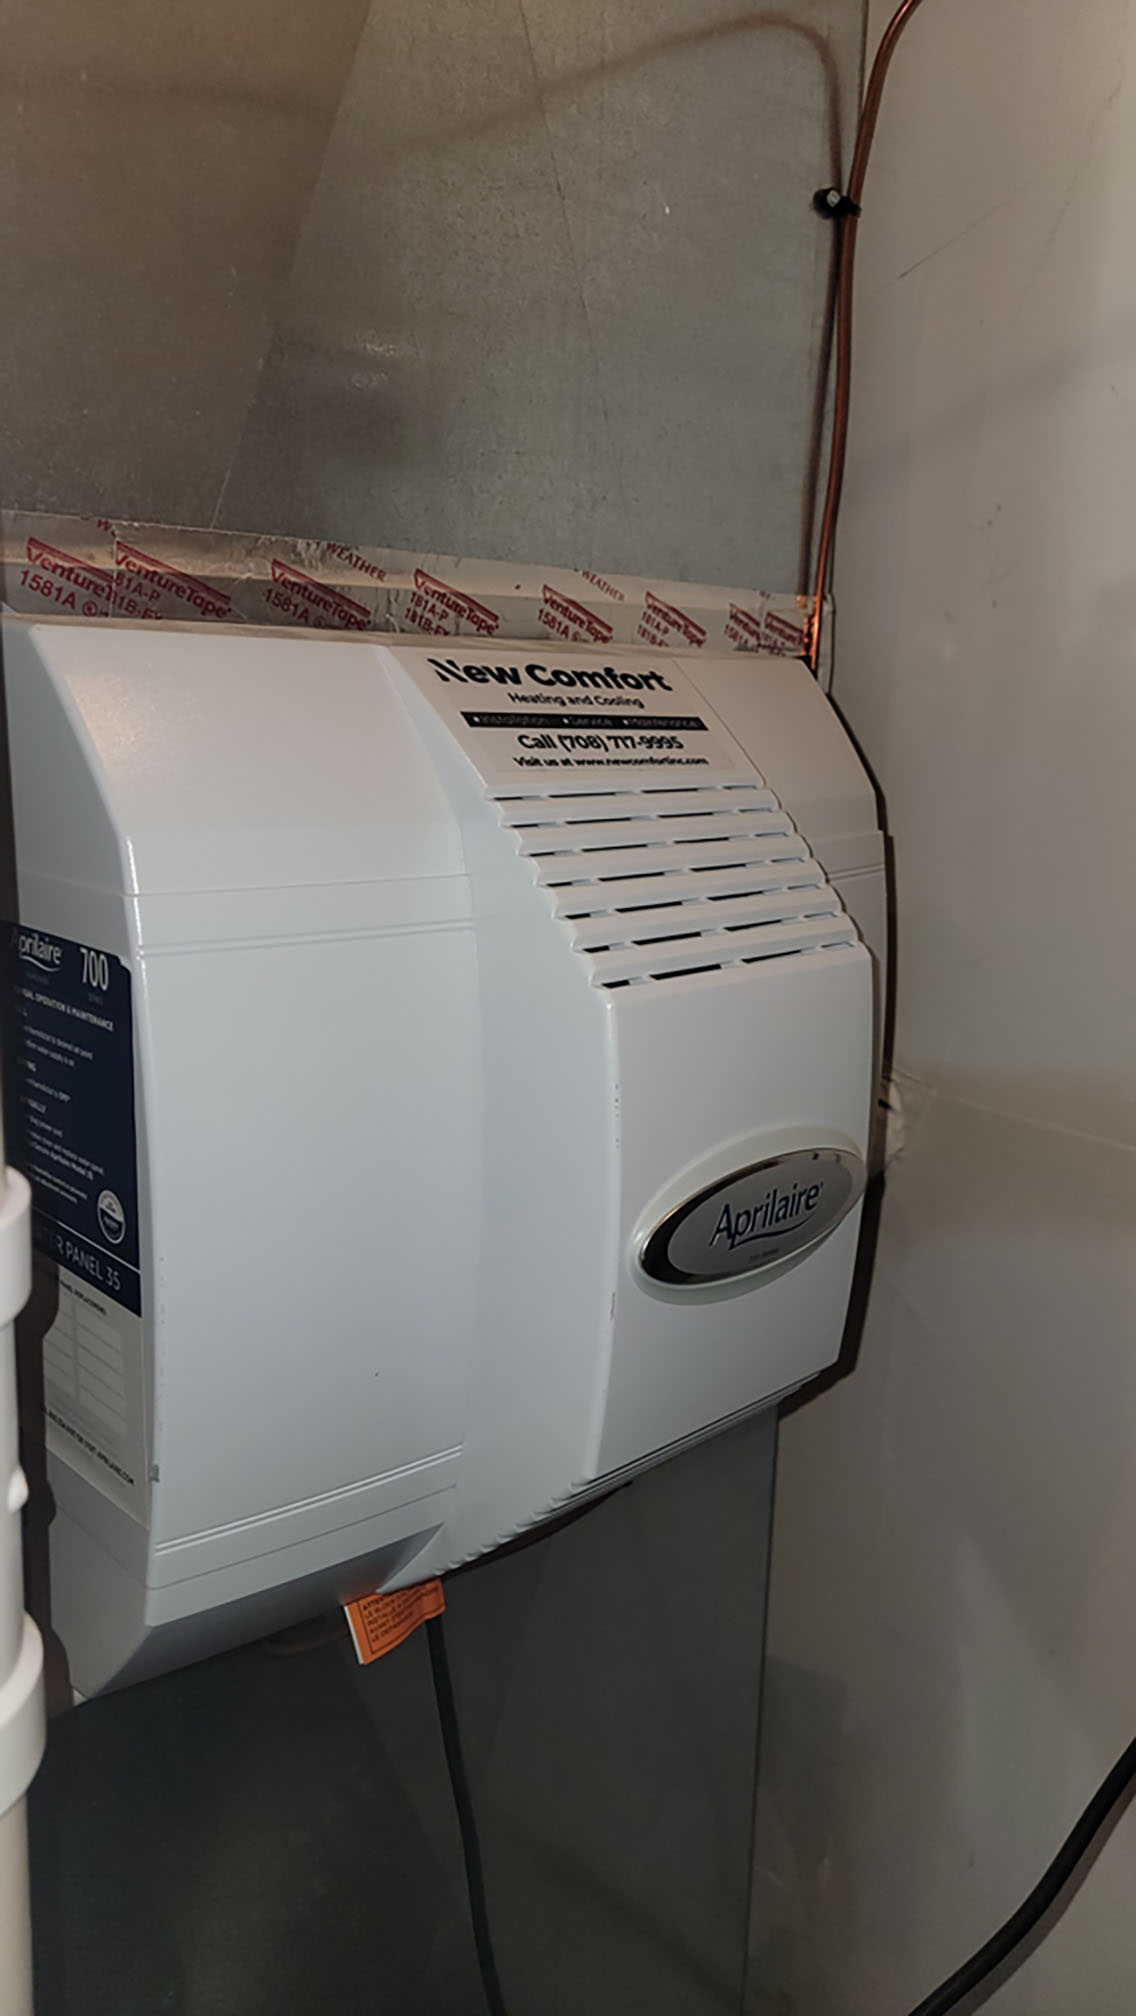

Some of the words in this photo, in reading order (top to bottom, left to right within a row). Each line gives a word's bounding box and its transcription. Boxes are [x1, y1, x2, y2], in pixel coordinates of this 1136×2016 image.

[326, 543, 387, 582] WEATHER
[19, 569, 76, 610] 1581A
[115, 551, 226, 619] VentureTape
[264, 588, 309, 623] 1581A
[271, 566, 368, 632] VentureTape
[582, 571, 625, 601] WEATHER
[415, 577, 499, 636] VentureTape
[538, 608, 570, 640] 1581A
[543, 588, 612, 644] VentureTape
[646, 600, 705, 648] VentureTape
[427, 658, 522, 686] New
[525, 664, 673, 692] Comfort
[507, 692, 567, 707] Heating
[567, 694, 592, 706] and
[595, 695, 645, 709] Cooling
[513, 756, 542, 767] Visit
[543, 758, 559, 767] us
[560, 757, 573, 767] at
[517, 734, 555, 749] Call
[557, 735, 609, 752] (708)
[606, 736, 684, 749] 717-9995
[80, 947, 110, 992] 700
[708, 1181, 821, 1251] Aprilaire
[65, 1240, 104, 1281] PANEL
[104, 1265, 121, 1291] 35
